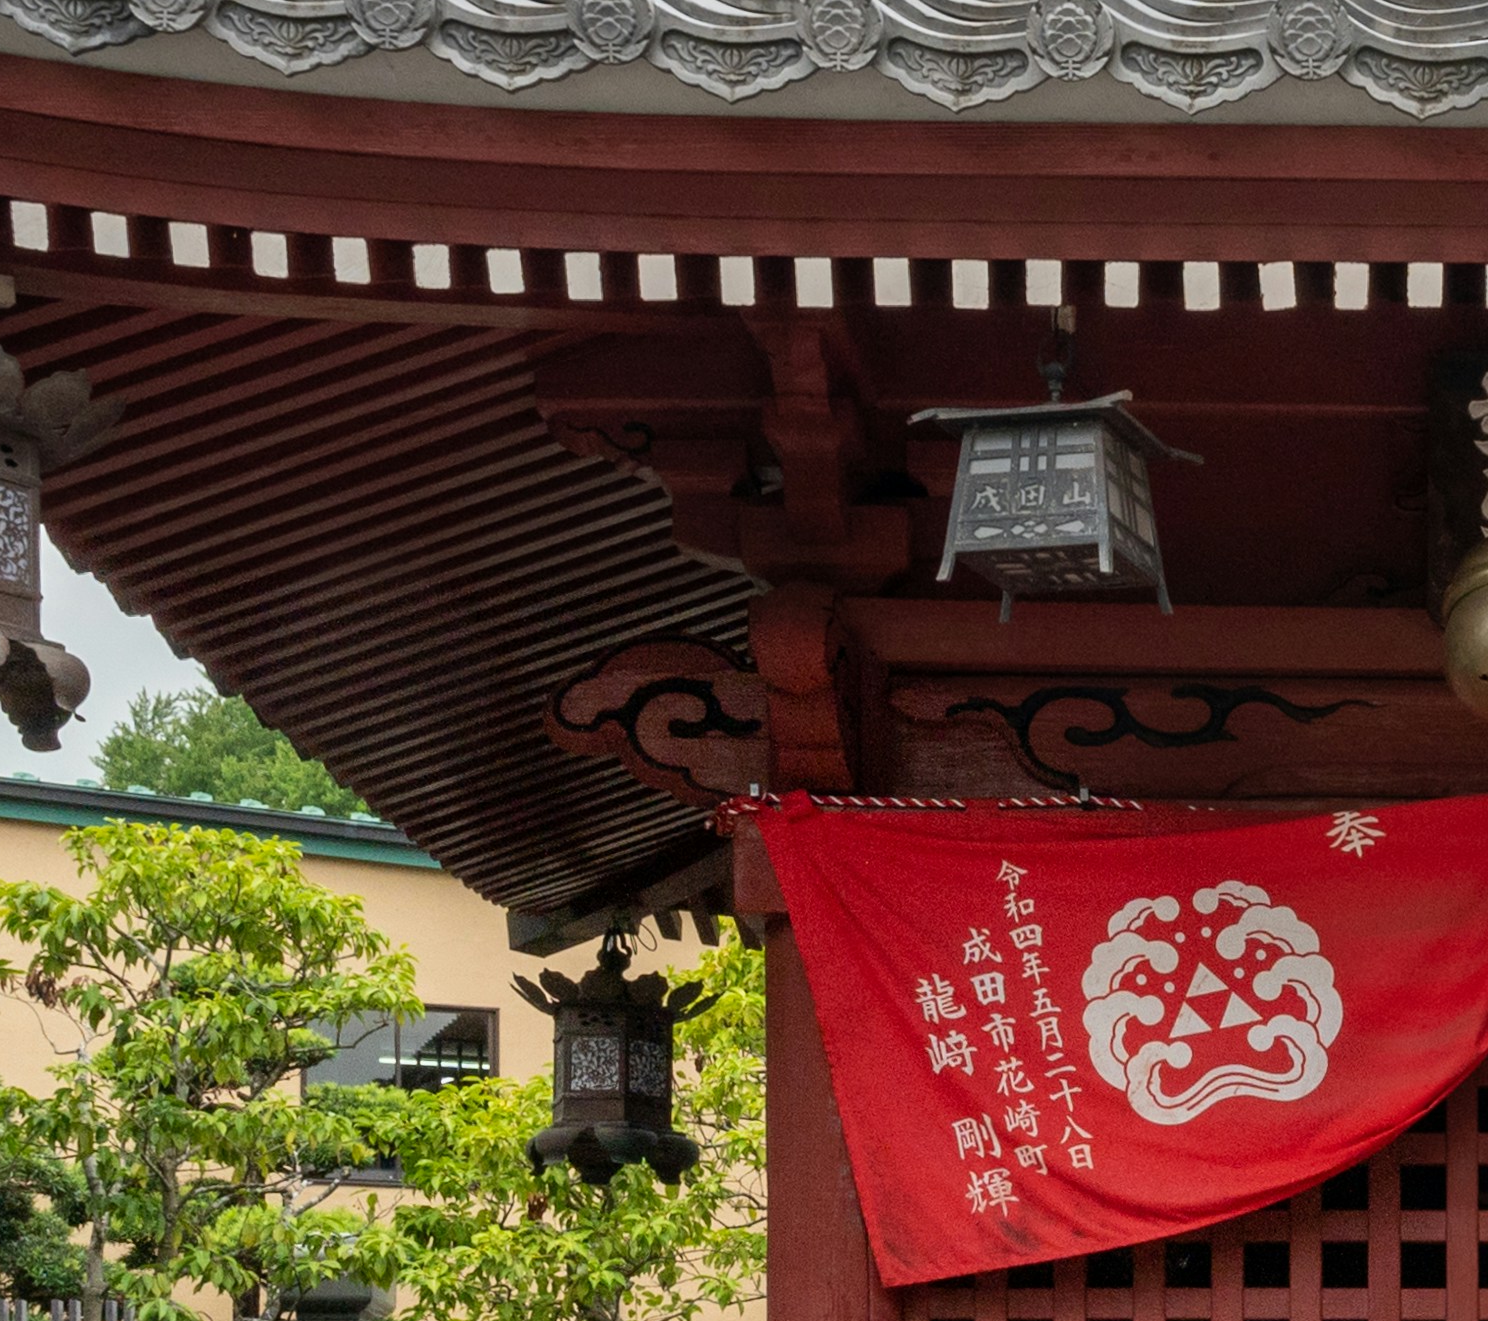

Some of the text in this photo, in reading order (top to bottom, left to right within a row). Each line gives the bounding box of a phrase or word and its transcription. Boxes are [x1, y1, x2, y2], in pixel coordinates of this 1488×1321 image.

[1326, 811, 1385, 857] 奉
[963, 929, 1048, 1176] 成田市花崎町
[996, 860, 1095, 1171] 令和四年五月二十八日
